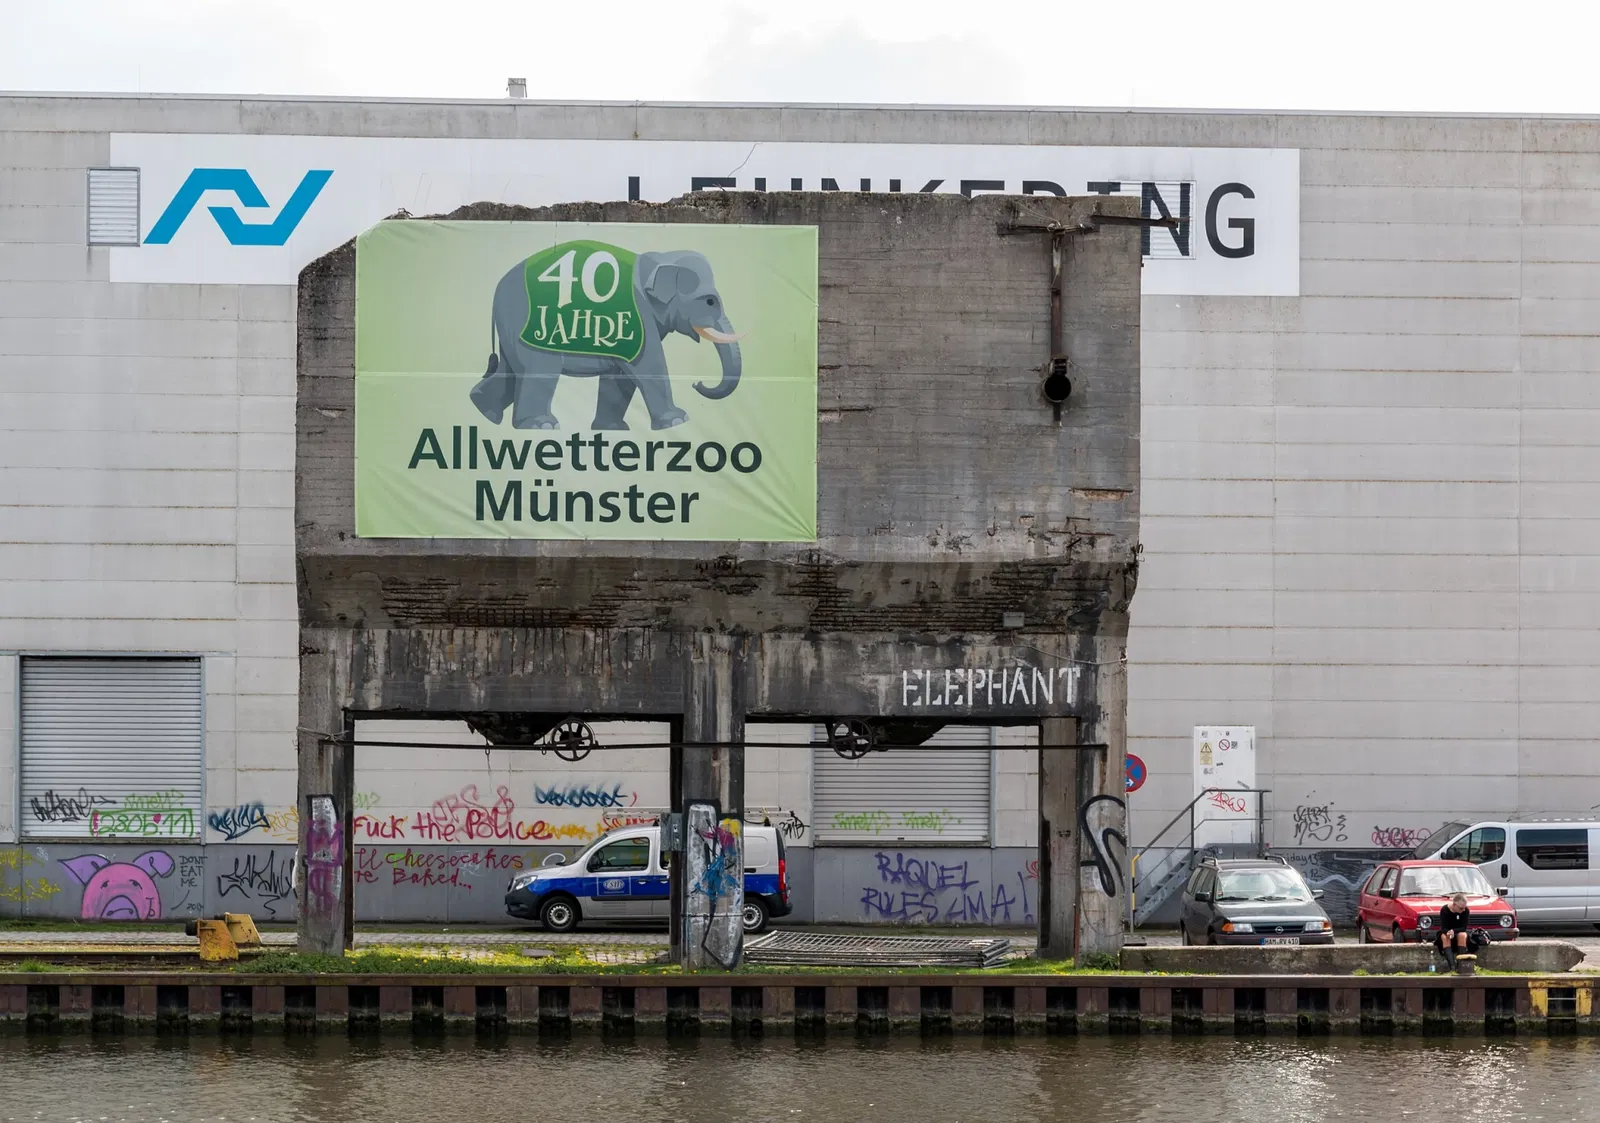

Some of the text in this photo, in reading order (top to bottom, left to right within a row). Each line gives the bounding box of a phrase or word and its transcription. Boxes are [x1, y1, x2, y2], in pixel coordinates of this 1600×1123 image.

[537, 249, 620, 309] 40
[533, 304, 634, 347] JAHRE
[408, 425, 762, 473] Allwetterzoo
[475, 478, 699, 524] Münster
[902, 666, 1081, 707] ELEPHANT
[411, 812, 456, 842] the
[466, 805, 554, 841] Police
[179, 855, 208, 865] DONT
[180, 866, 203, 877] EAT
[386, 848, 525, 870] cheesecakes
[874, 852, 979, 891] RAQUEL
[180, 878, 198, 888] ME
[861, 887, 939, 923] RULES
